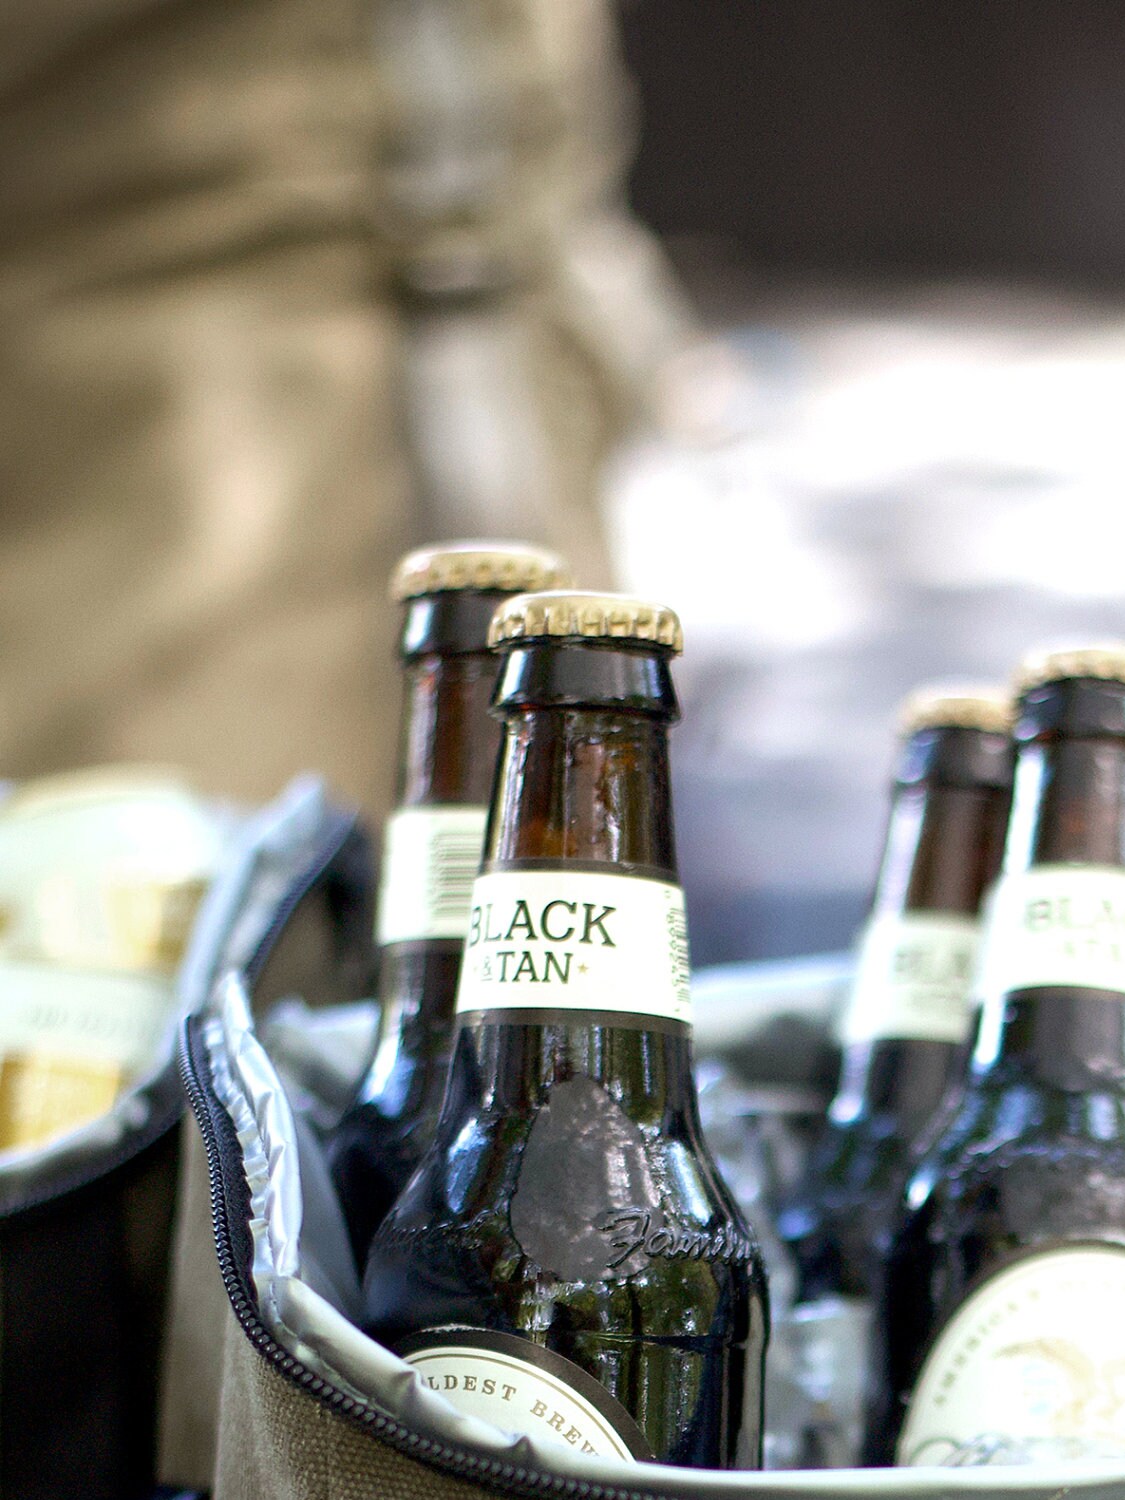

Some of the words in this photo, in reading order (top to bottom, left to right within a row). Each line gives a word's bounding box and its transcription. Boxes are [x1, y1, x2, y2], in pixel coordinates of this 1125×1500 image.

[470, 900, 617, 947] BLACK
[496, 951, 574, 984] TAN
[427, 1373, 518, 1402] LDEST
[529, 1398, 601, 1458] BREW
